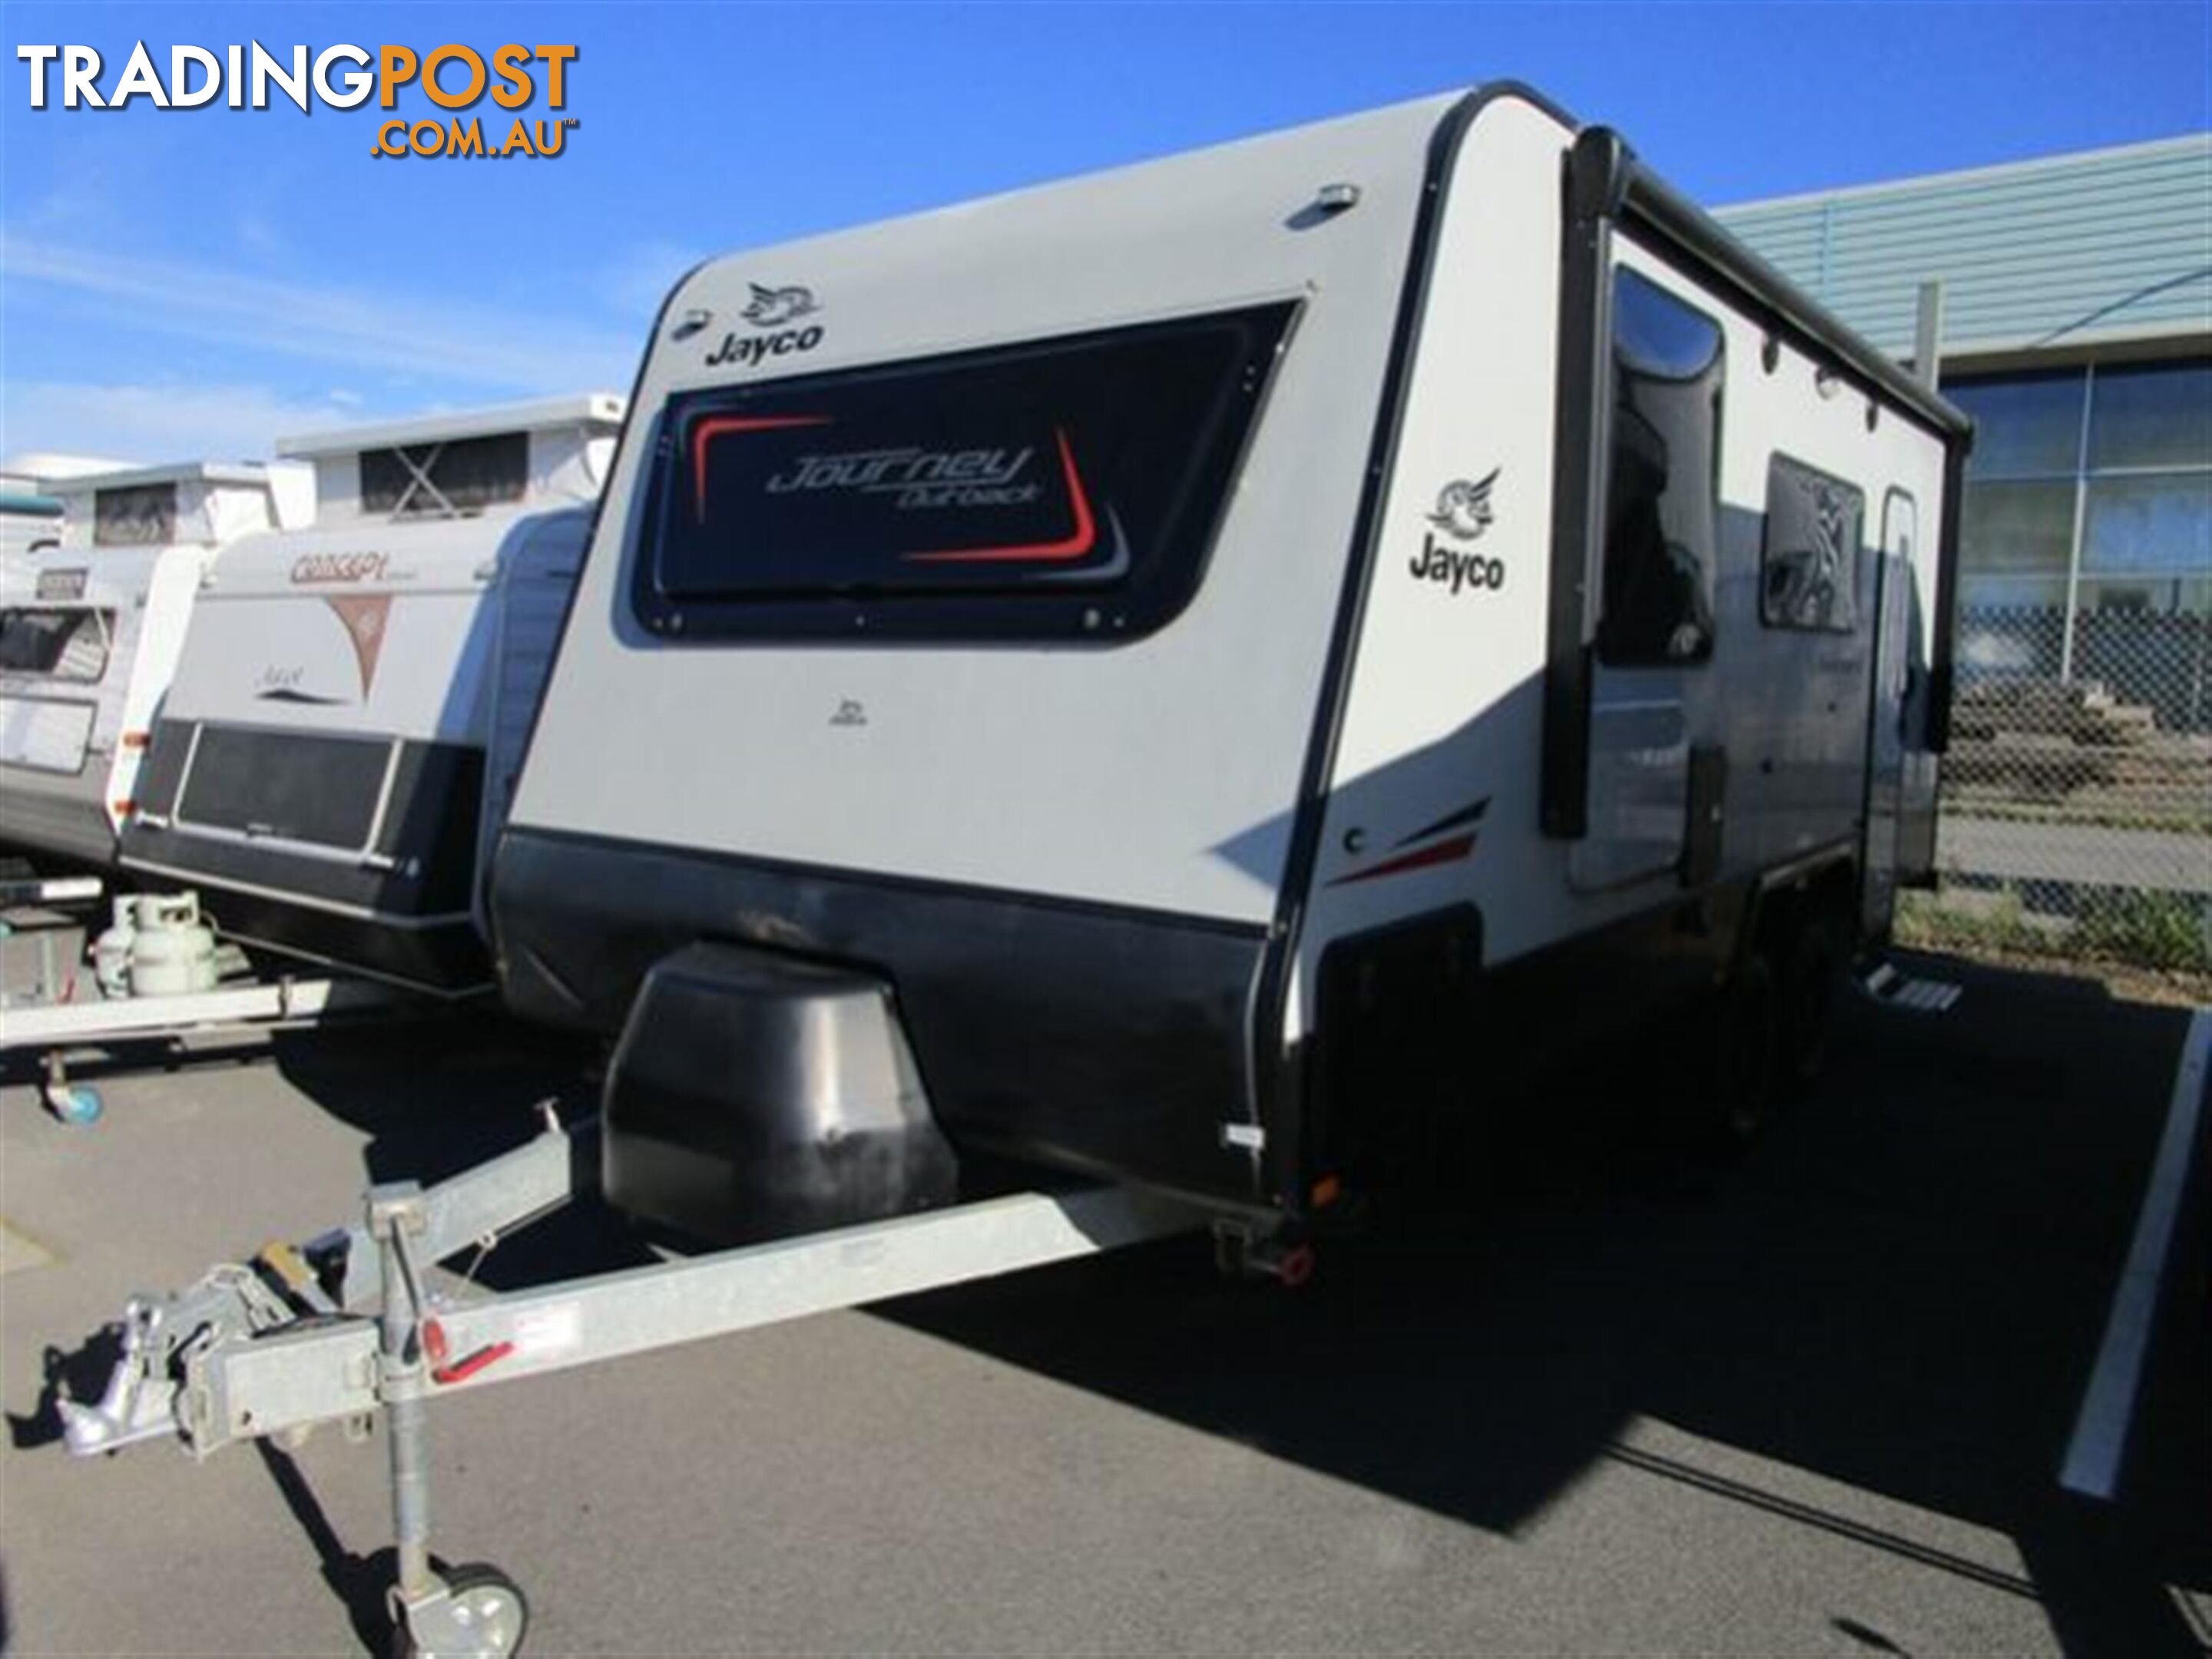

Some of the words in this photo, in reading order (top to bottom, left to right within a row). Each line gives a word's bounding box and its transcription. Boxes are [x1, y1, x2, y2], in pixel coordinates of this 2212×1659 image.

[705, 325, 824, 367] Jayco
[765, 445, 1035, 493] Journey
[1409, 531, 1505, 596] Jayco
